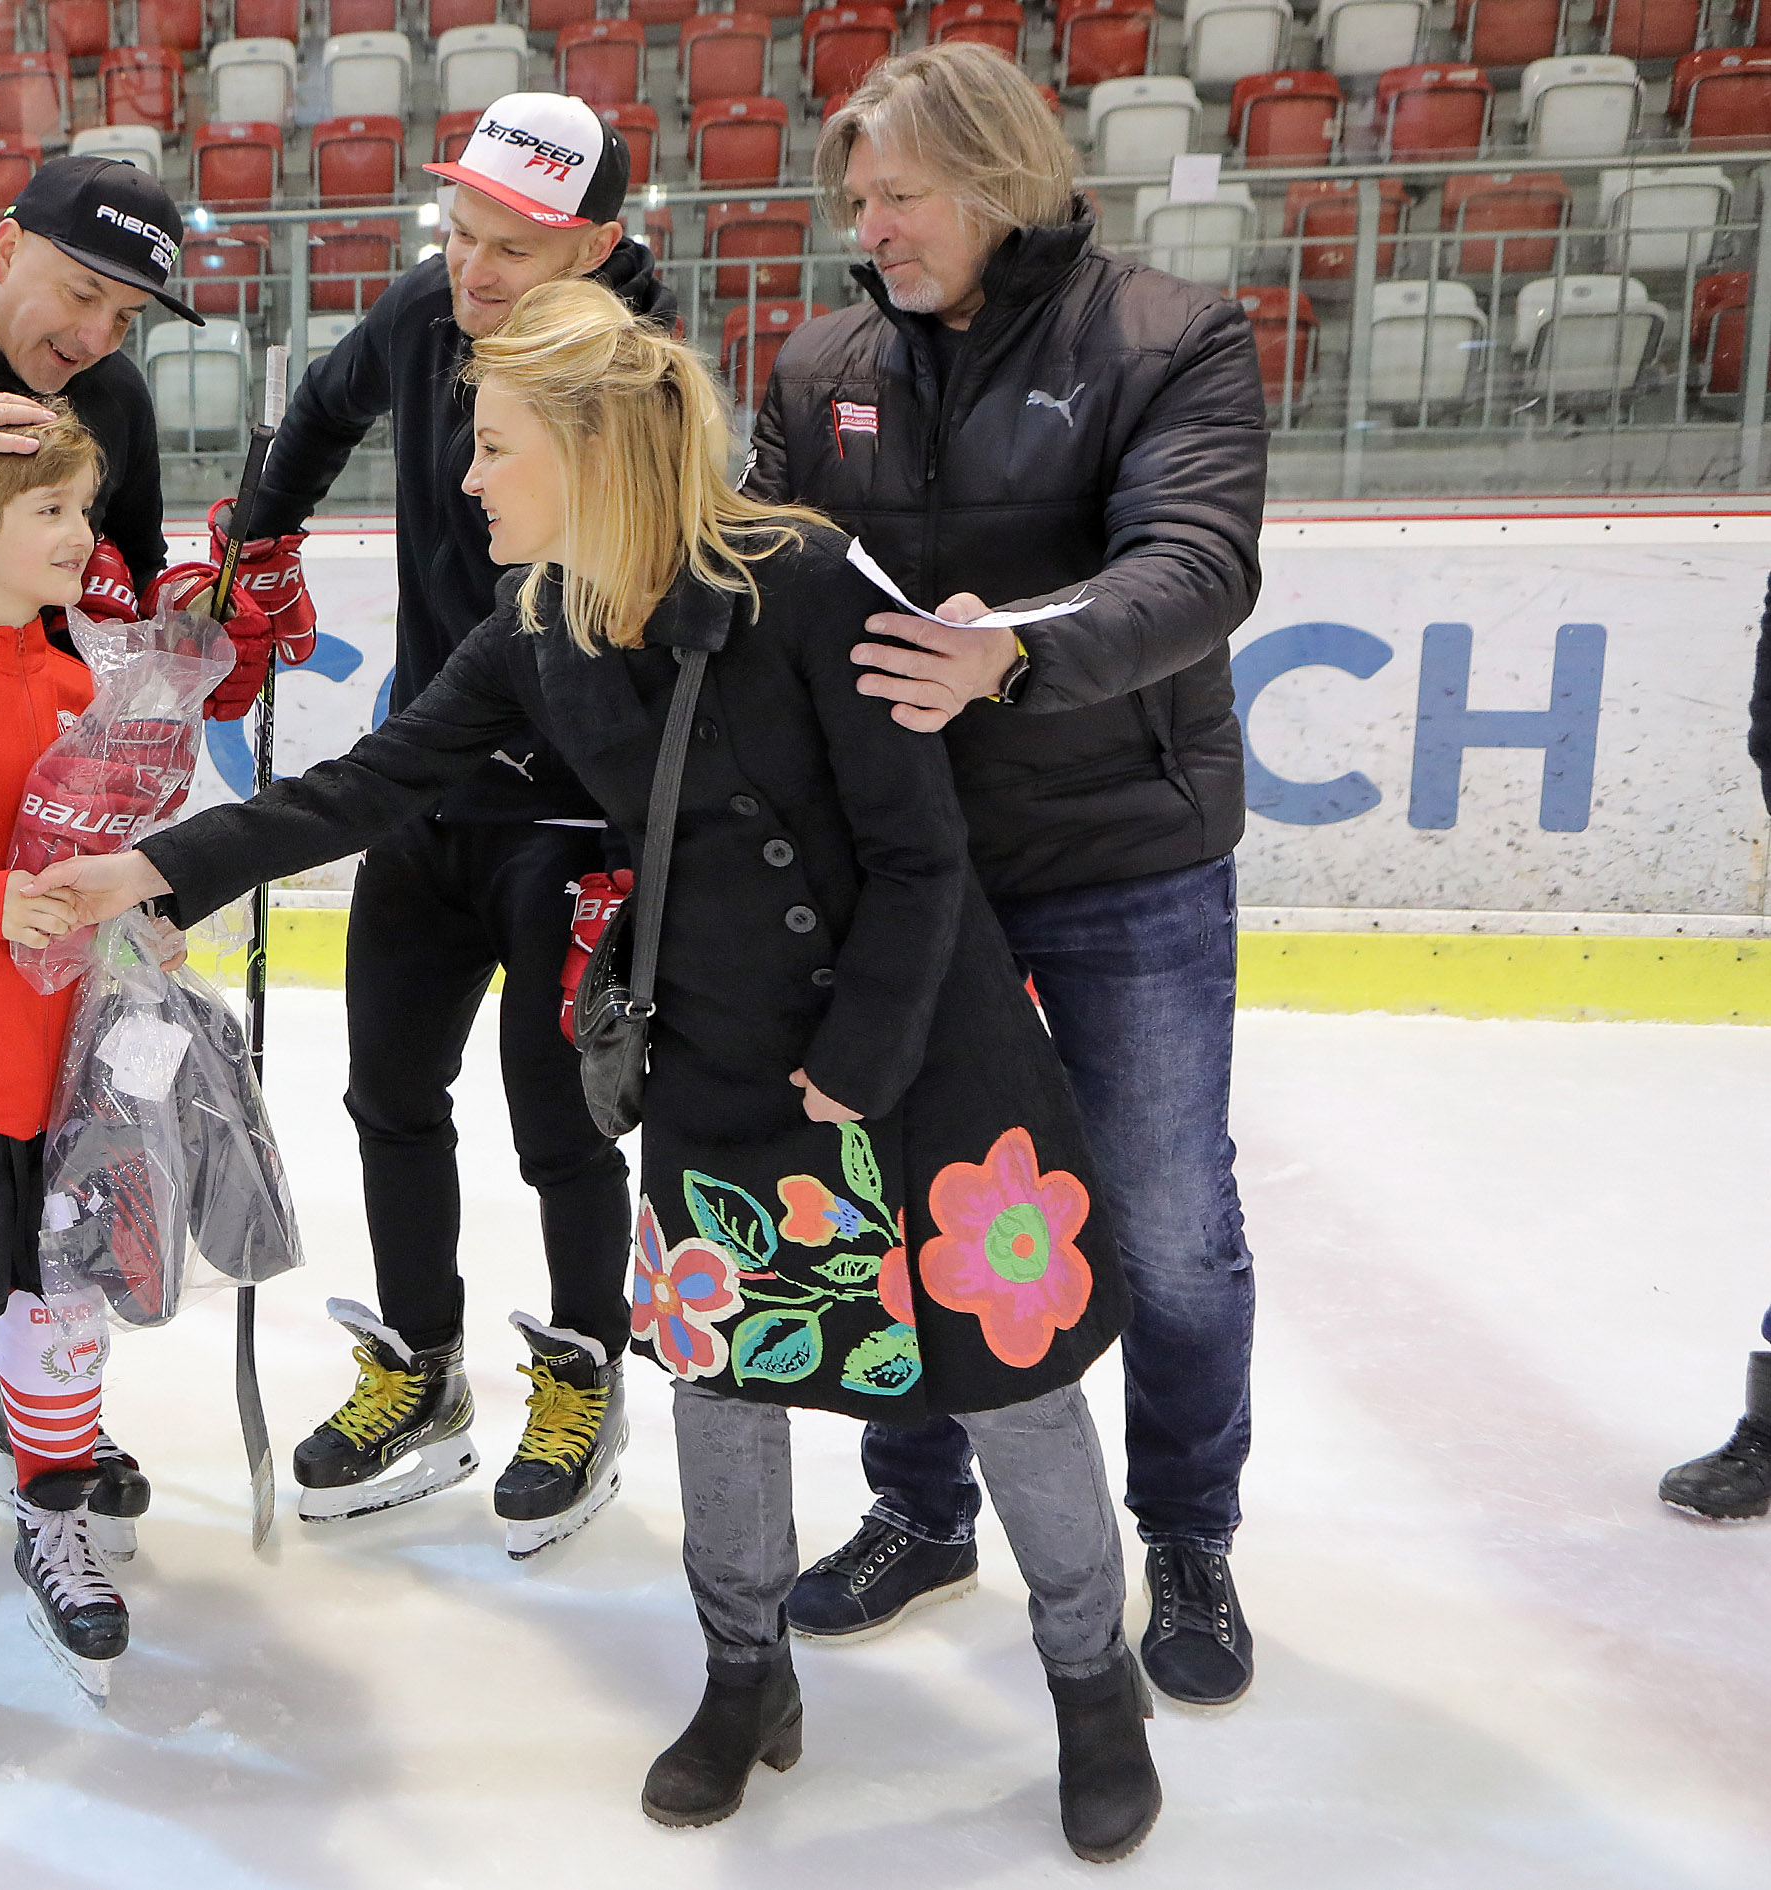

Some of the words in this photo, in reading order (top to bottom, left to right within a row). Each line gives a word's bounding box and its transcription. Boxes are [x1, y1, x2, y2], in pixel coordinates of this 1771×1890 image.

[524, 155, 572, 182] FT1
[530, 211, 571, 223] CCM
[549, 1352, 579, 1367] CCM
